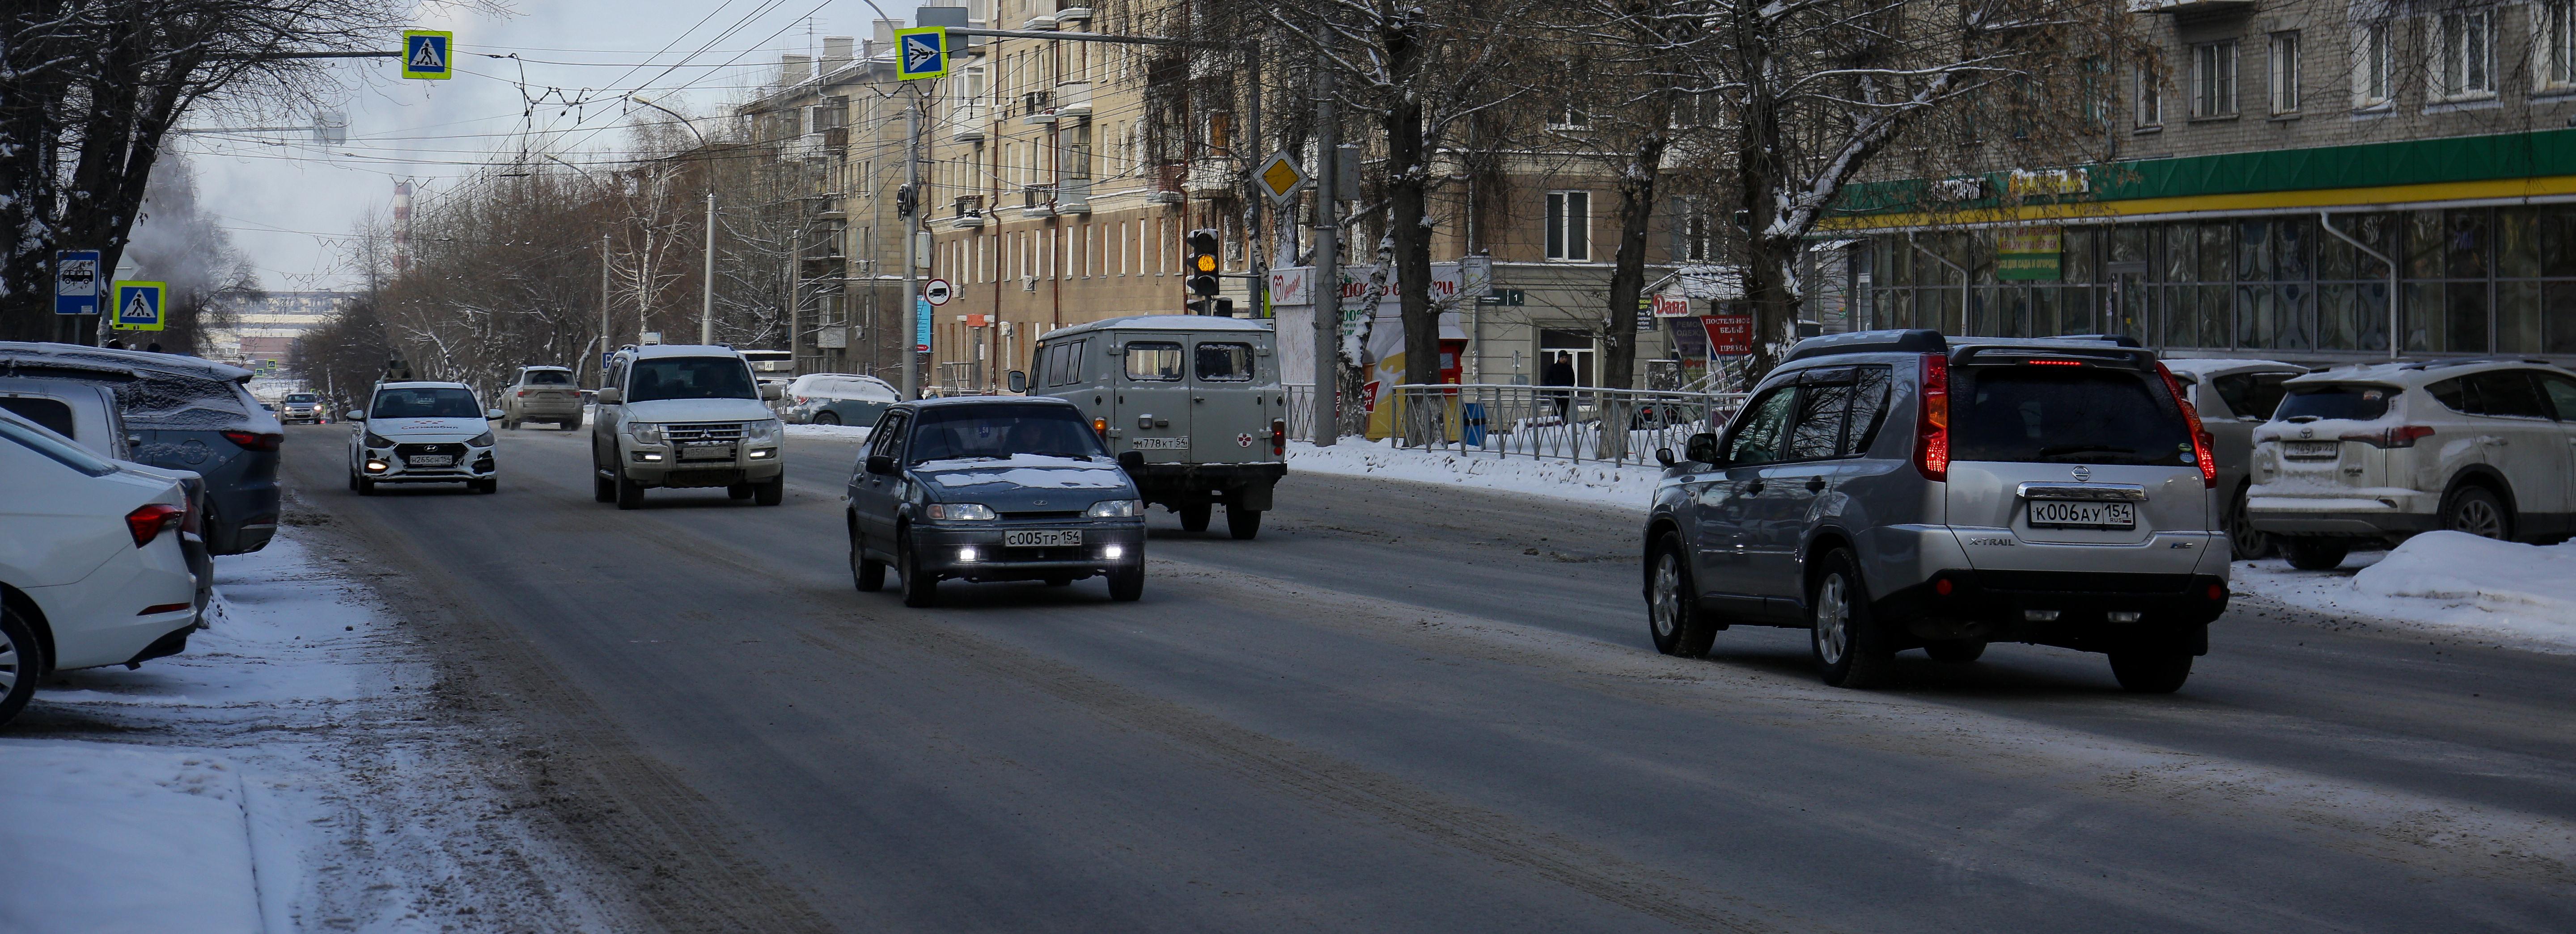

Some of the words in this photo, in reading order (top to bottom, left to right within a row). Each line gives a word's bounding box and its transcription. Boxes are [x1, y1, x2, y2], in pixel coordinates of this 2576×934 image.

[1720, 325, 1743, 334] БЕЛЬЁ
[2036, 503, 2101, 521] К006АУ
[2104, 504, 2129, 518] 154
[1009, 532, 1057, 545] С005ТР
[1061, 531, 1080, 541] 154
[1969, 537, 2015, 546] X-TRAIL
